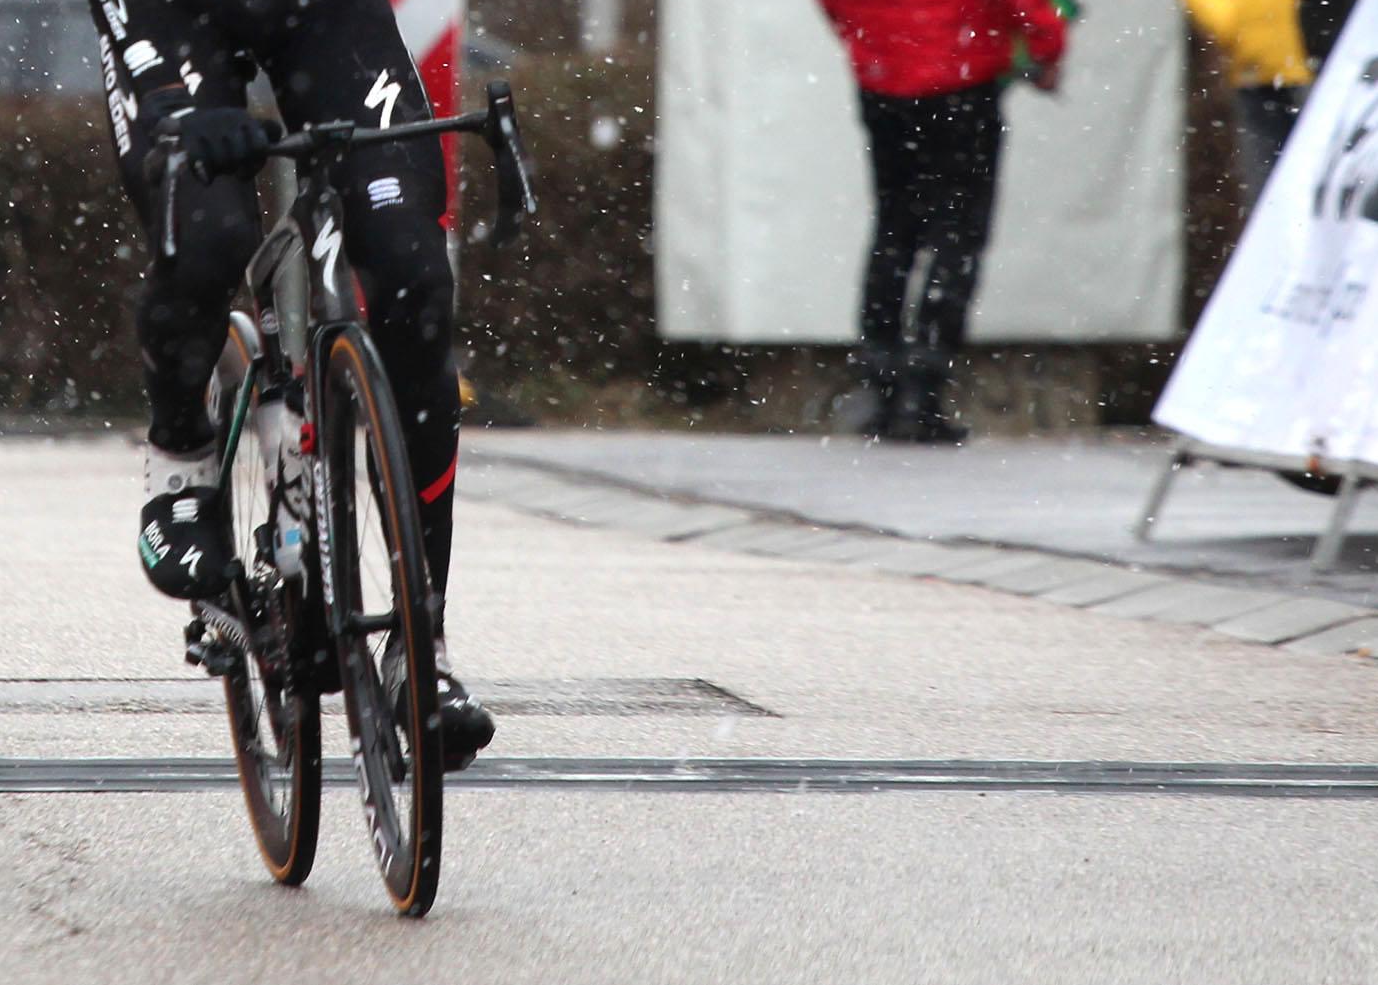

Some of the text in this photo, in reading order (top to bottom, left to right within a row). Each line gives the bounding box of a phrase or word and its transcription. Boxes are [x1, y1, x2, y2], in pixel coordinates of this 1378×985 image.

[102, 0, 127, 41] EDER
[108, 88, 131, 157] EDER
[144, 519, 171, 560] BORA
